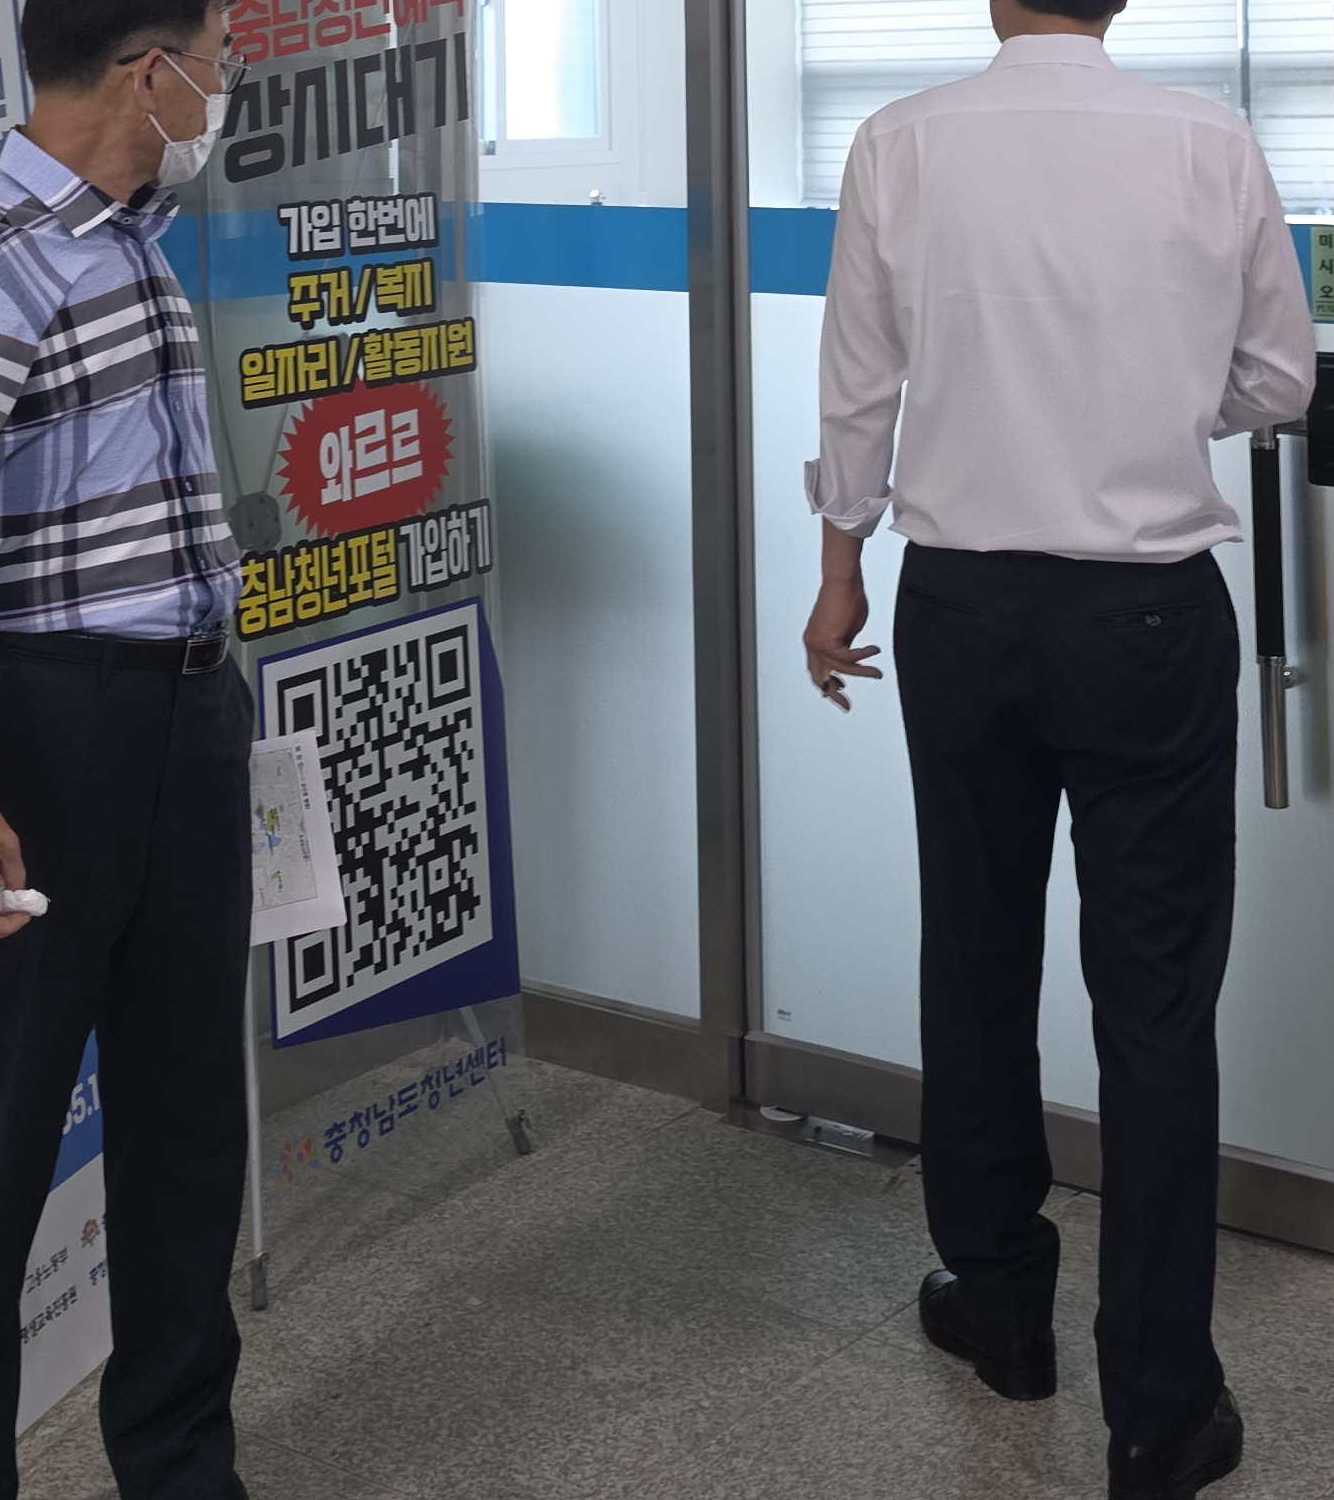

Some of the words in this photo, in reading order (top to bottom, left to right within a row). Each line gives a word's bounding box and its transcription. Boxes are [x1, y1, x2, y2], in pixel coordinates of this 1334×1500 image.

[220, 32, 469, 184] 상시대기
[278, 202, 343, 255] 가입
[345, 194, 437, 249] 한번에
[1318, 233, 1334, 299] 미시오
[240, 338, 340, 403] 일자리
[362, 318, 475, 383] 활동지원
[319, 408, 423, 505] 와르르
[238, 527, 398, 636] 충남청년포털
[399, 504, 490, 588] 가입하기
[323, 1036, 507, 1164] 충청남도청년센터
